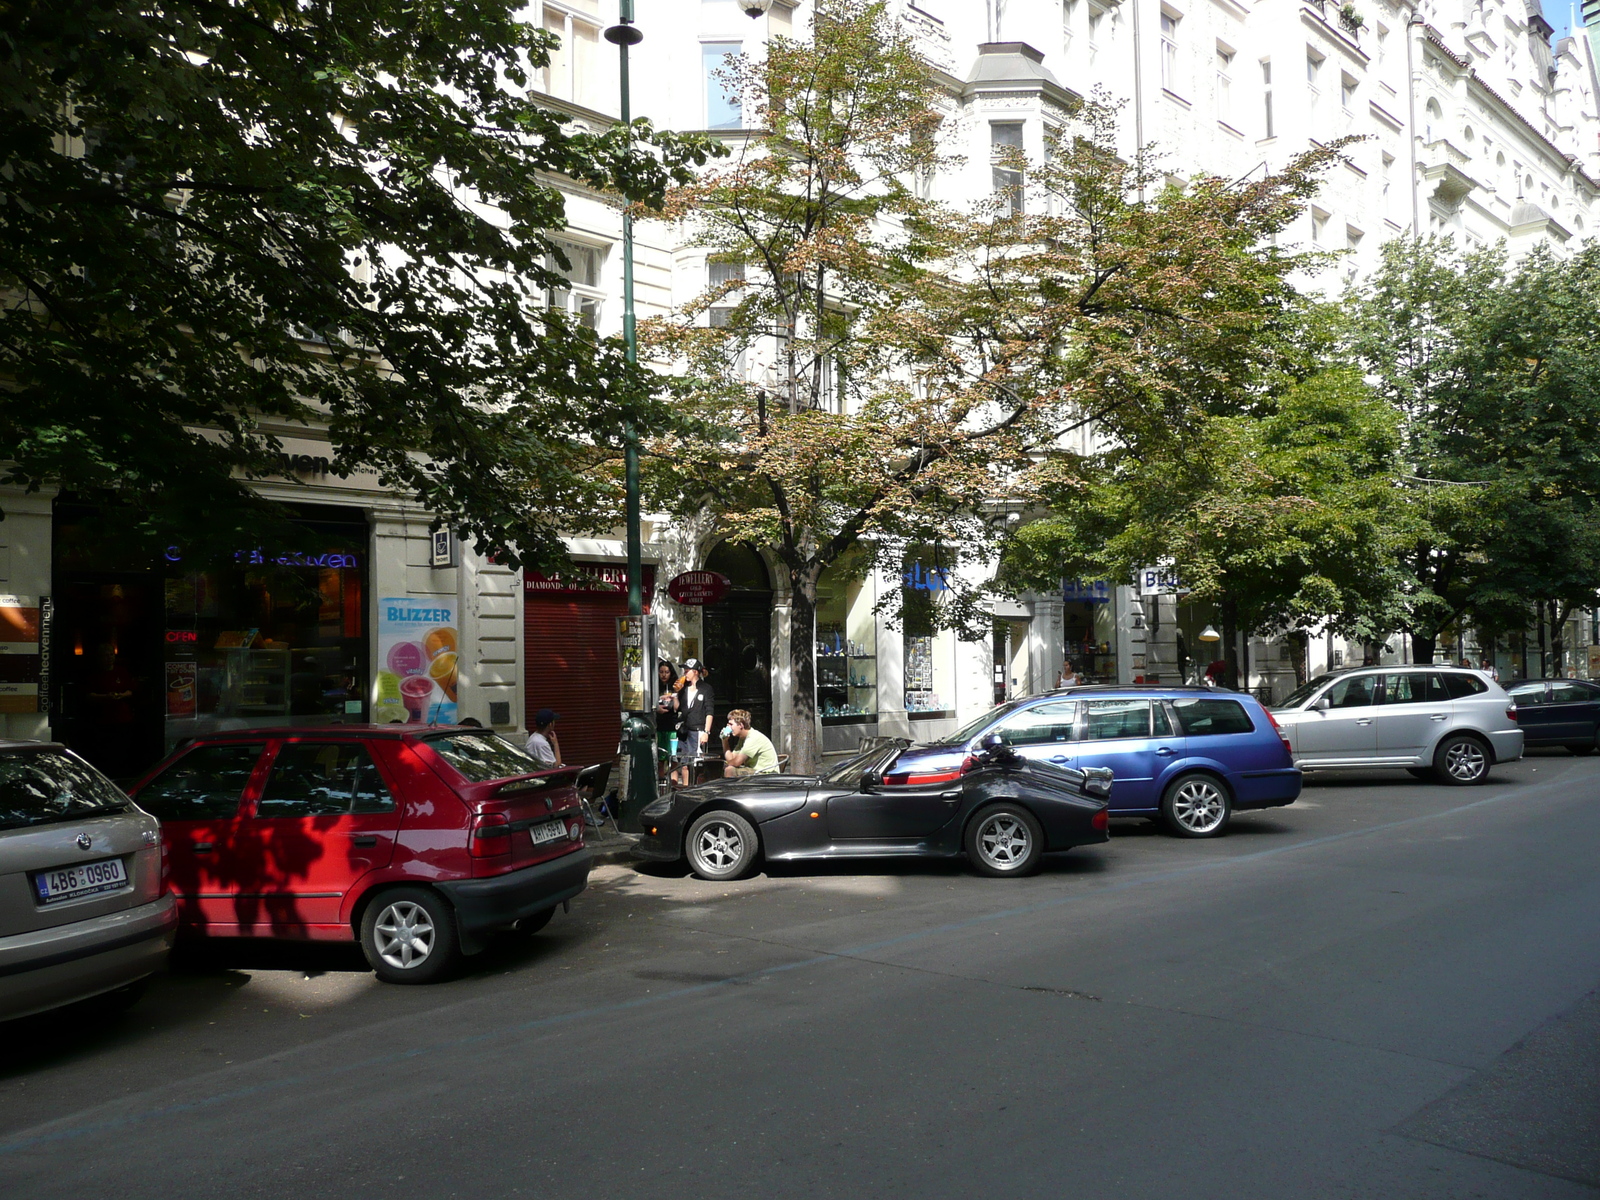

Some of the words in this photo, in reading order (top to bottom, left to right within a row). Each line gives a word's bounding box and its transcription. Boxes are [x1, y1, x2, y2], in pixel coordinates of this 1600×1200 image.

[387, 606, 451, 622] BLIZZER
[165, 631, 197, 643] OPEN
[51, 870, 78, 892] 4B6
[86, 861, 119, 884] 0960
